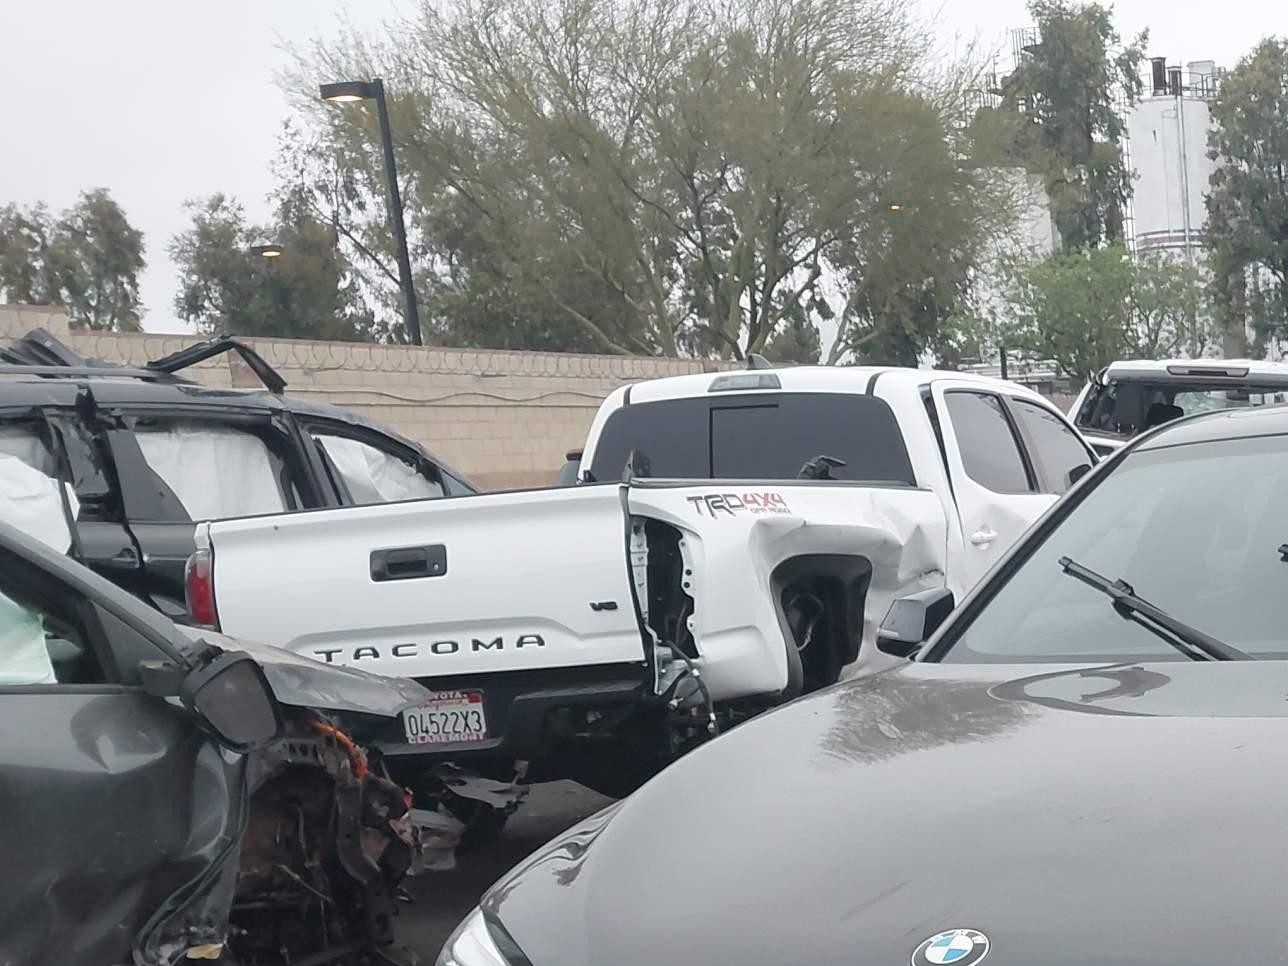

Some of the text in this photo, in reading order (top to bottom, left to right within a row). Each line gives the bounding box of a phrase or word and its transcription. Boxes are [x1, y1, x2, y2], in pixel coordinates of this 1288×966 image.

[313, 634, 546, 663] TACOMA
[408, 710, 482, 736] 04522X3
[408, 733, 485, 745] CLAREMONT
